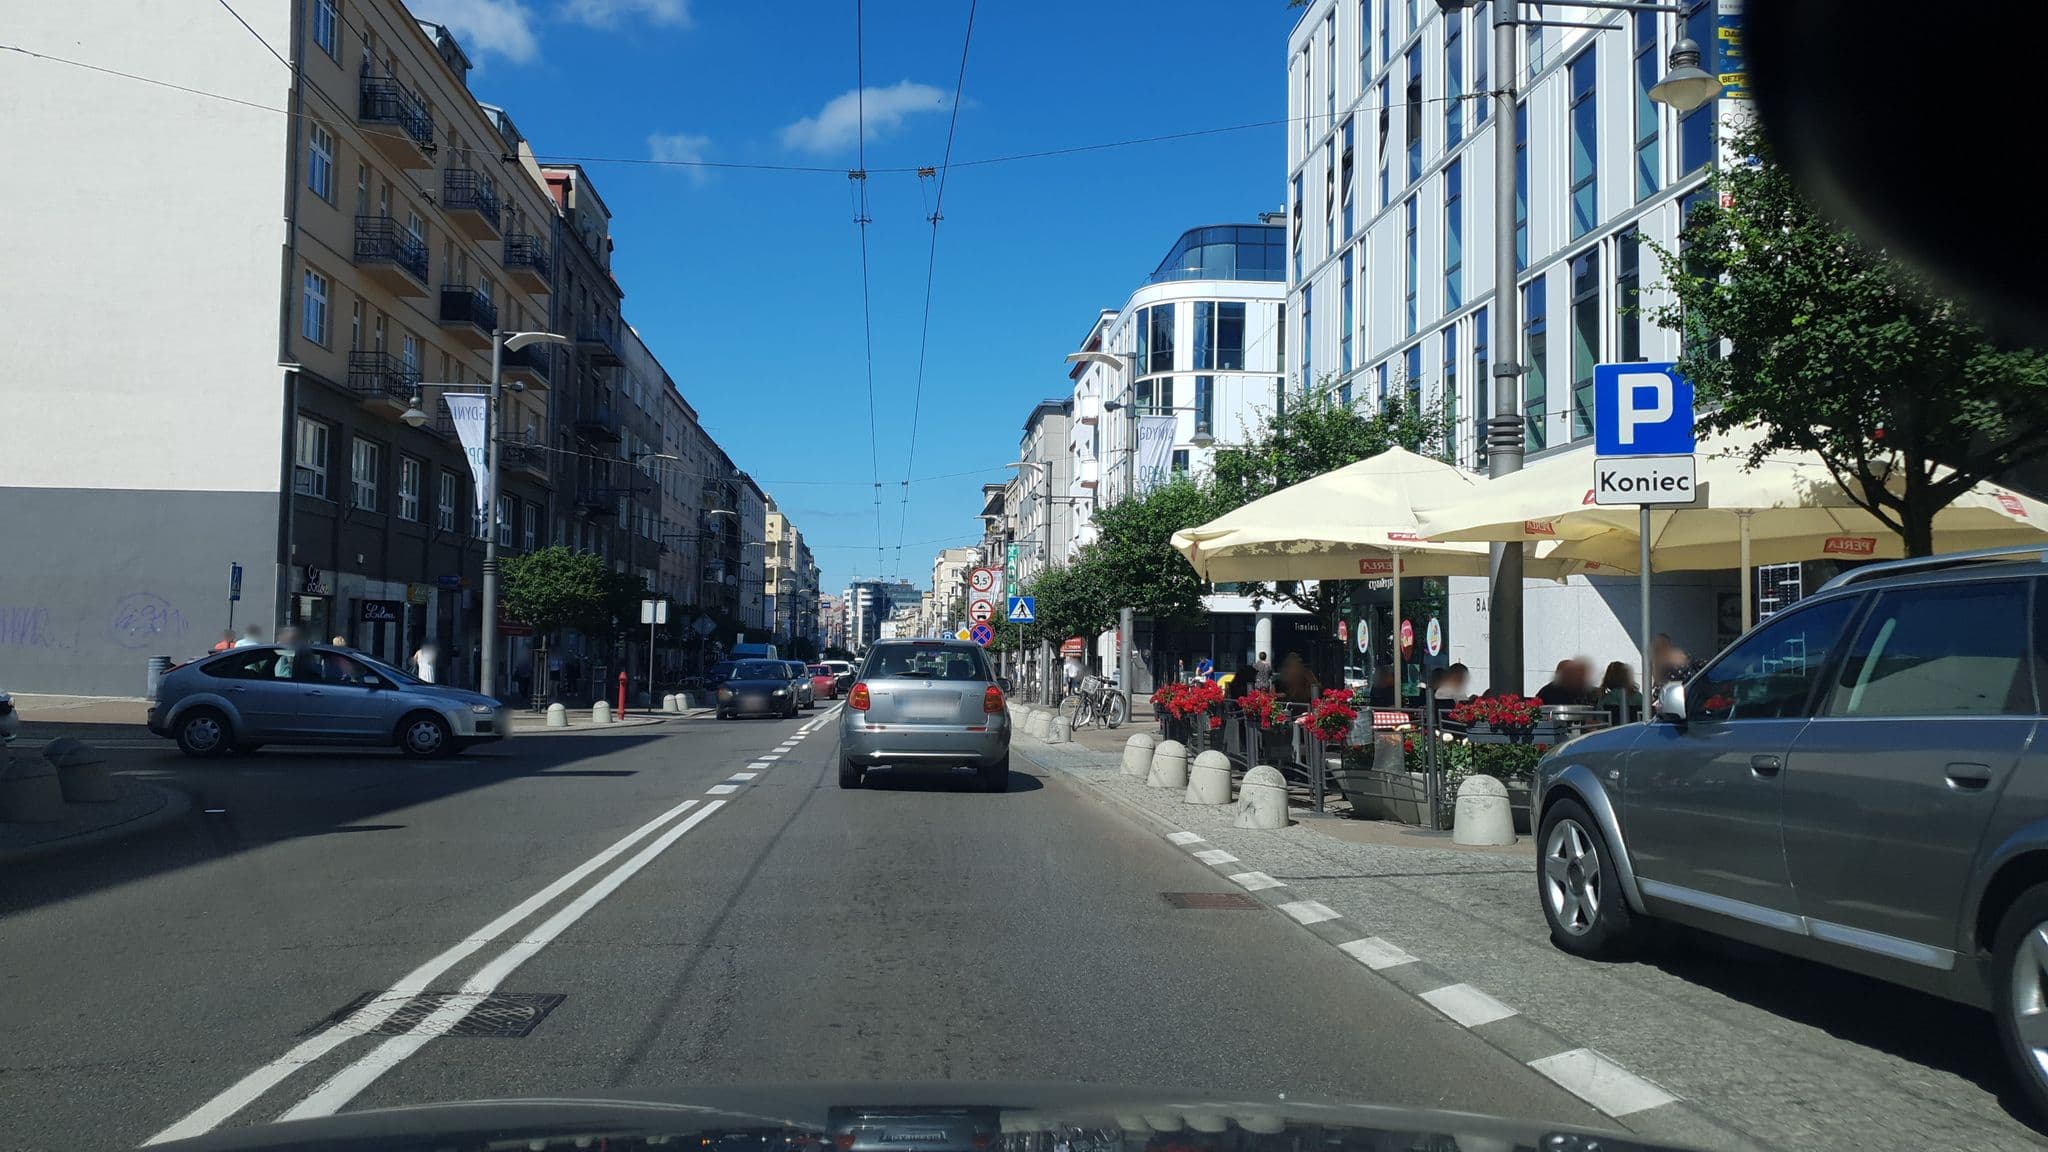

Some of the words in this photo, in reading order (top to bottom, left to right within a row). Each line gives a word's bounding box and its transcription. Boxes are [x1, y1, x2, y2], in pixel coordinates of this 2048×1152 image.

[1617, 372, 1674, 445] P
[1139, 426, 1174, 441] GDYNIA
[1600, 469, 1690, 492] Koniec
[1476, 597, 1490, 612] BA
